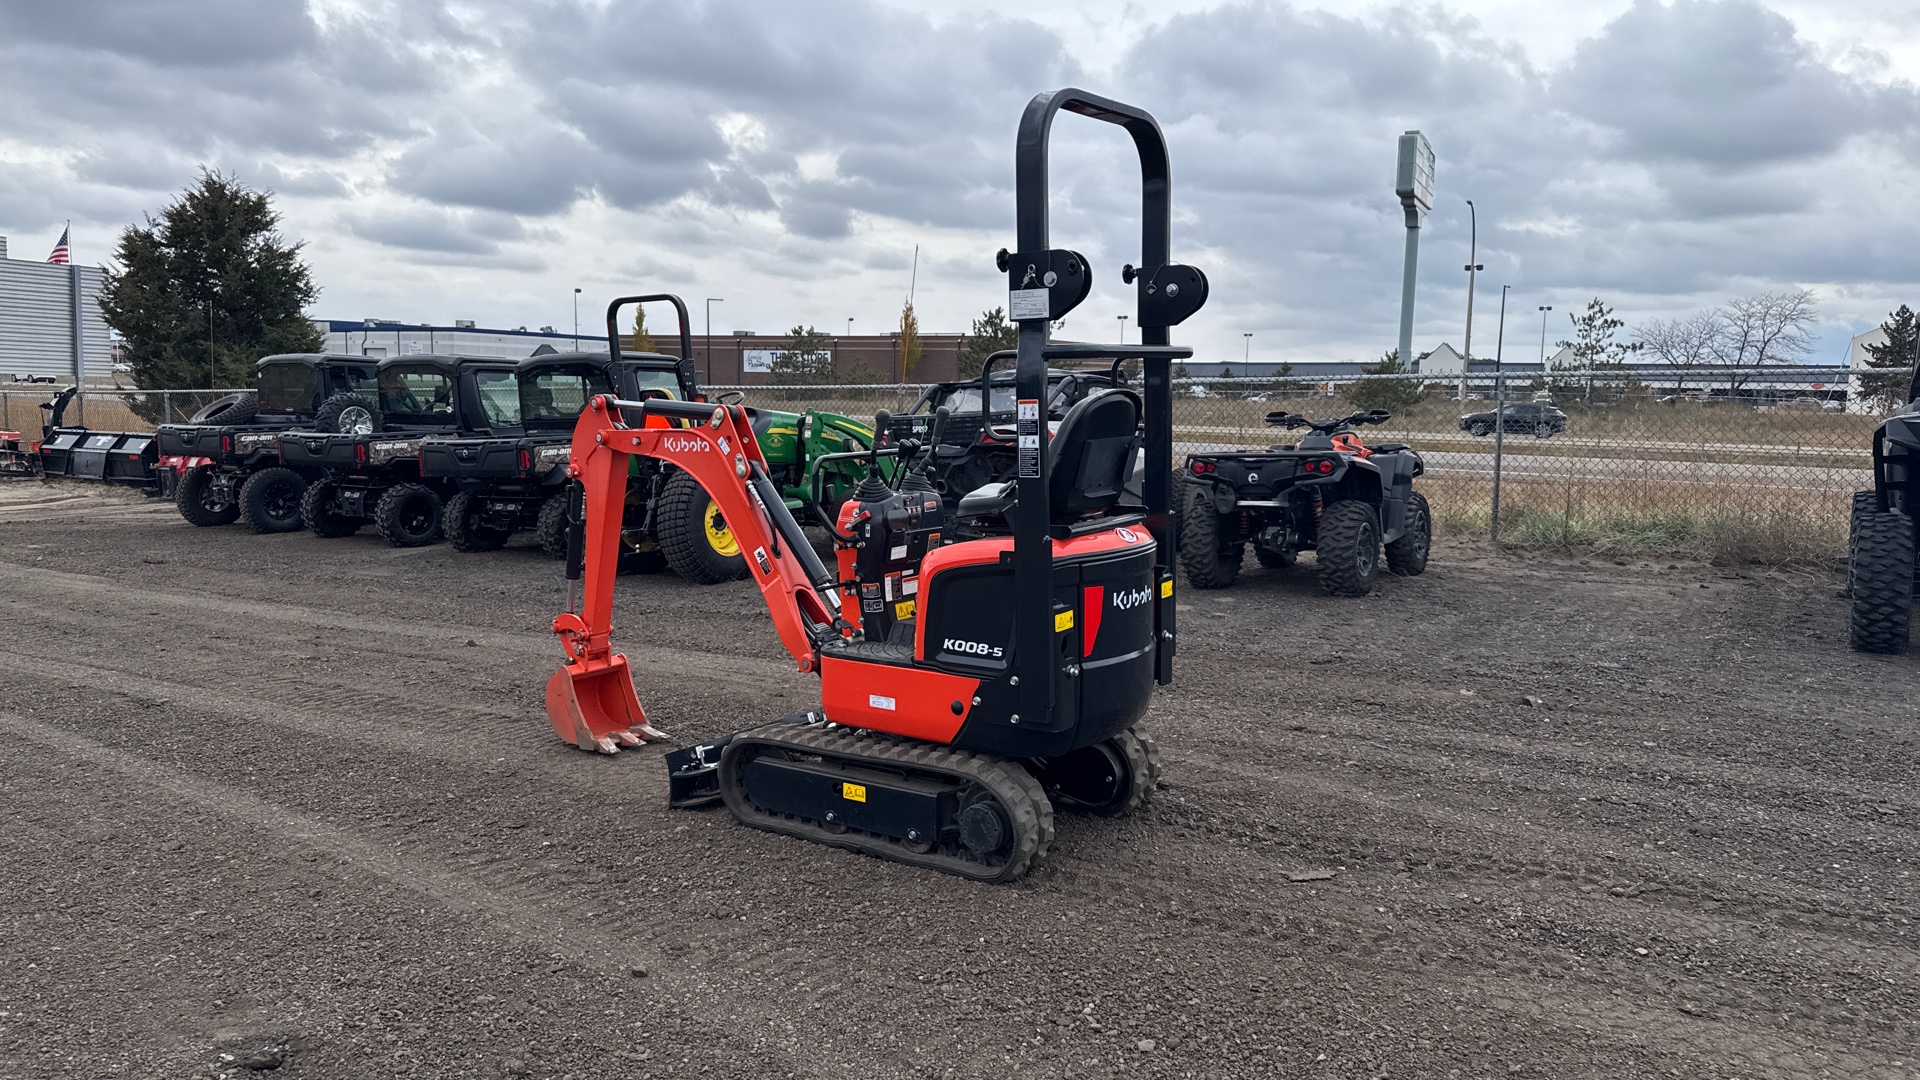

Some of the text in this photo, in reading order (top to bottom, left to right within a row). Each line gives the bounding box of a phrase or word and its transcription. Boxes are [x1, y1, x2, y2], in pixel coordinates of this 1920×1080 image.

[664, 437, 710, 452] Kubota
[1113, 585, 1152, 610] Kubota
[943, 638, 1003, 657] K008-5
